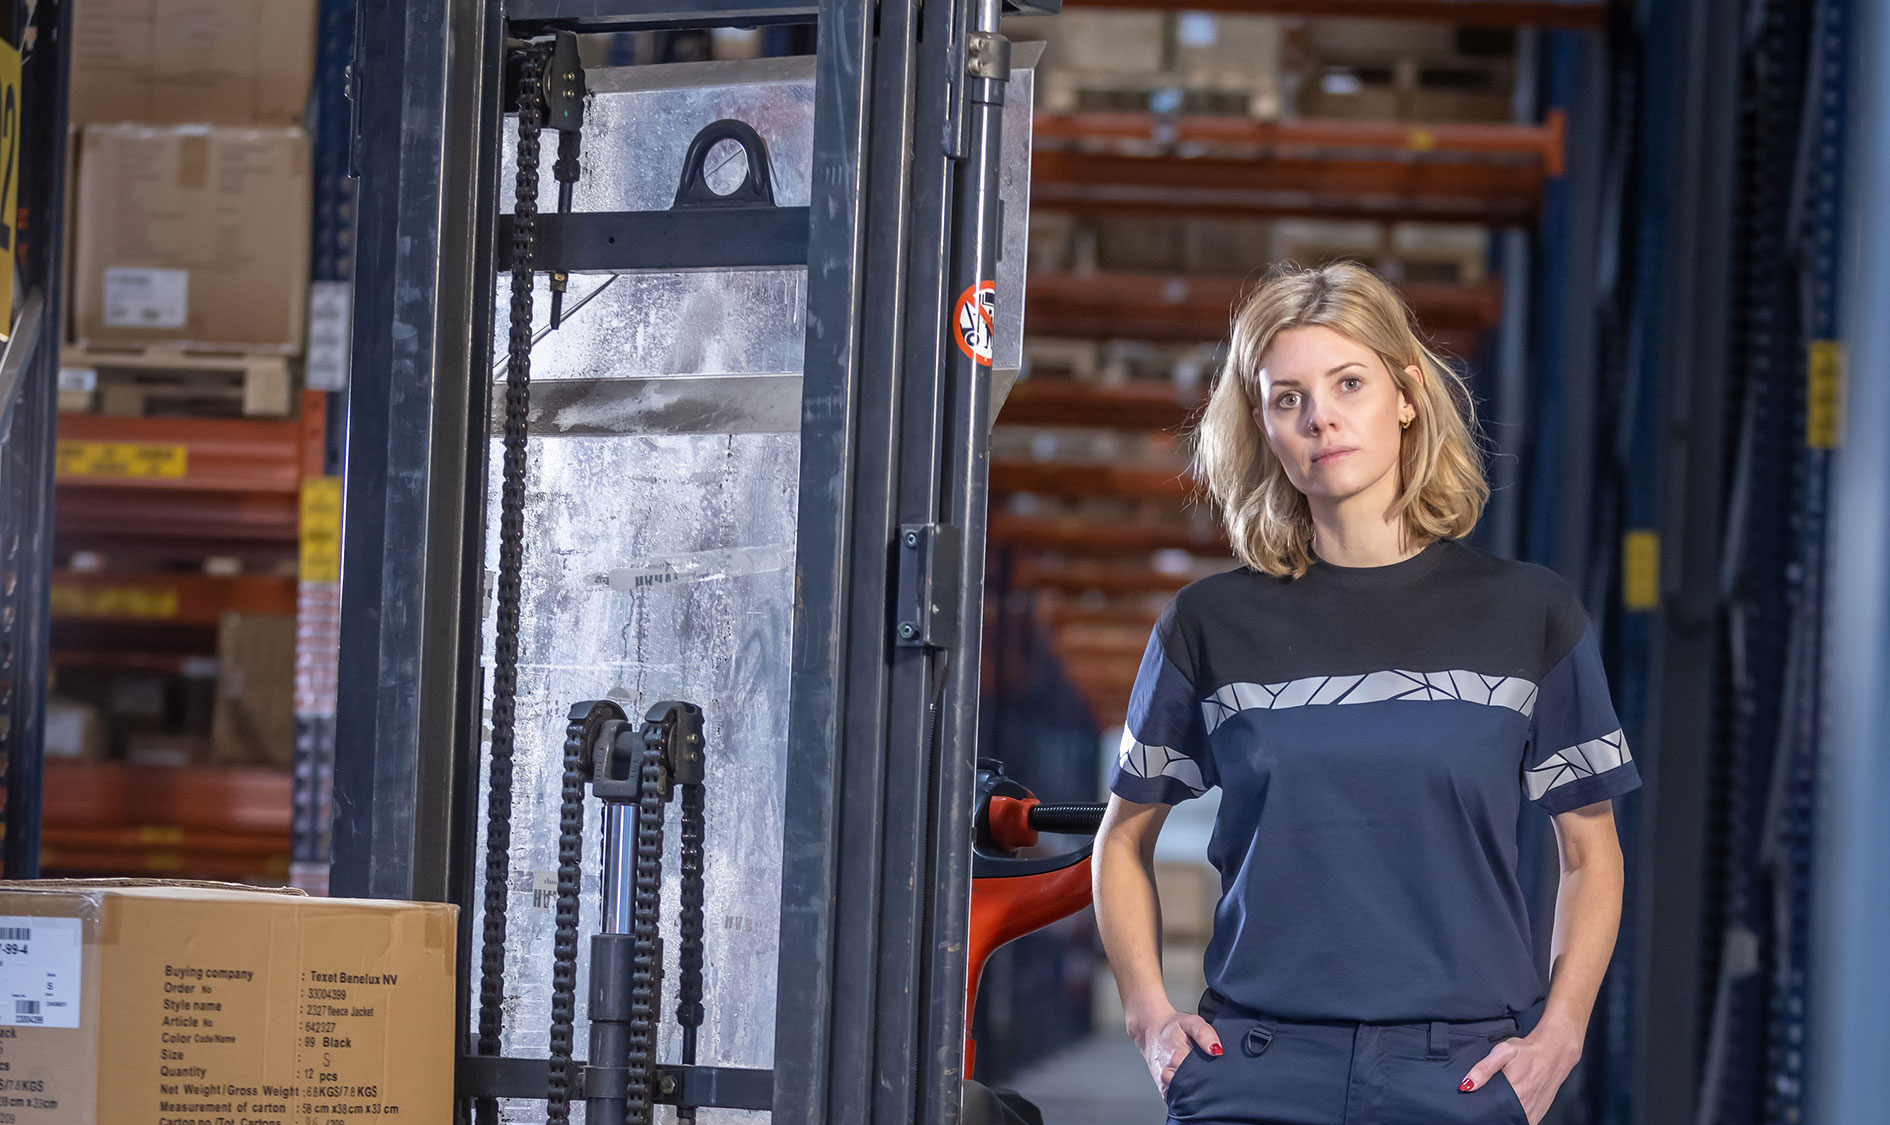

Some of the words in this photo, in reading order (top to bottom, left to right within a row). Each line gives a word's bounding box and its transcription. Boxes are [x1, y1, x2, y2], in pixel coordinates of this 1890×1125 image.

[0, 944, 28, 955] -99-4
[165, 965, 203, 980] Buying
[205, 969, 253, 982] company
[311, 970, 337, 983] Texet
[340, 972, 380, 985] Benelux
[383, 974, 398, 985] NV
[164, 982, 194, 994] Order
[308, 988, 346, 1001] 33004399
[163, 999, 191, 1013] Style
[193, 1002, 222, 1011] name
[351, 1006, 374, 1017] Jacket
[162, 1016, 199, 1027] Article
[305, 1021, 337, 1034] 642327
[161, 1032, 192, 1044] Color
[304, 1036, 316, 1048] 99
[323, 1036, 352, 1048] Black
[161, 1049, 185, 1061] Size
[160, 1065, 207, 1080] Quantity
[304, 1068, 315, 1080] 12
[320, 1072, 338, 1083] pcs
[160, 1084, 179, 1095] Net
[262, 1085, 299, 1099] Weight
[160, 1101, 232, 1113] Measurement
[237, 1102, 248, 1113] of
[252, 1102, 286, 1113] carton
[302, 1103, 312, 1115] 58
